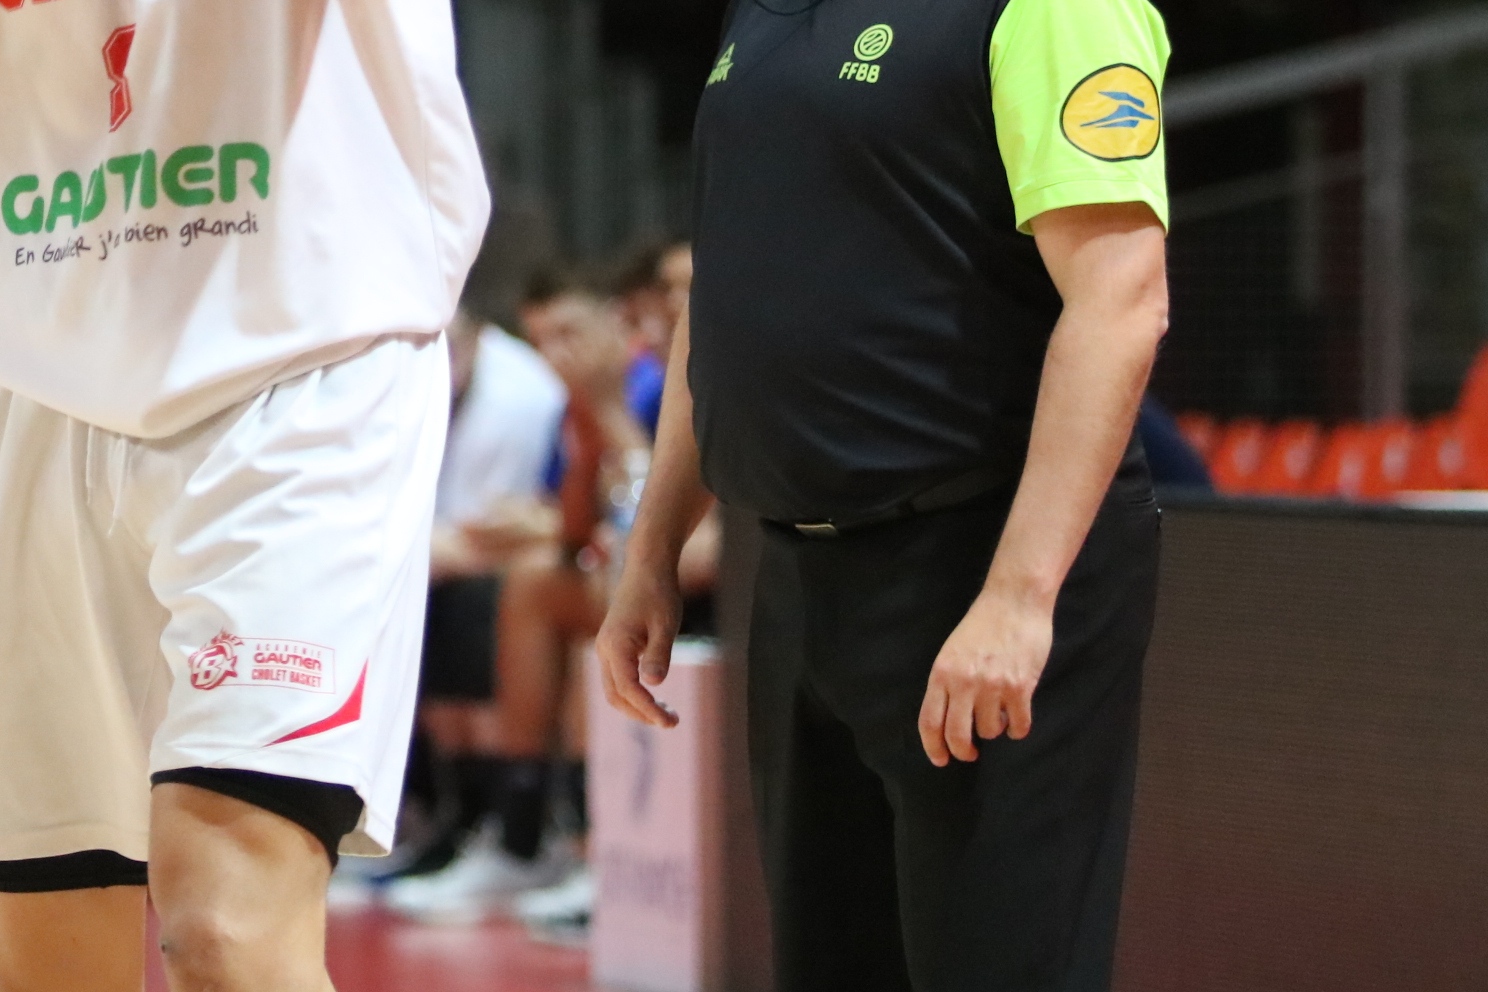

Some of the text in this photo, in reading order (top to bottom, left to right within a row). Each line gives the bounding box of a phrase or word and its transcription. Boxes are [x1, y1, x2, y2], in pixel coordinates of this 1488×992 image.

[838, 61, 881, 84] FFBB
[1, 141, 271, 236] GAUTIER
[15, 246, 36, 266] En
[124, 224, 169, 243] bien
[253, 652, 322, 671] GAUTIER
[252, 668, 322, 688] CHOLET BASKET
